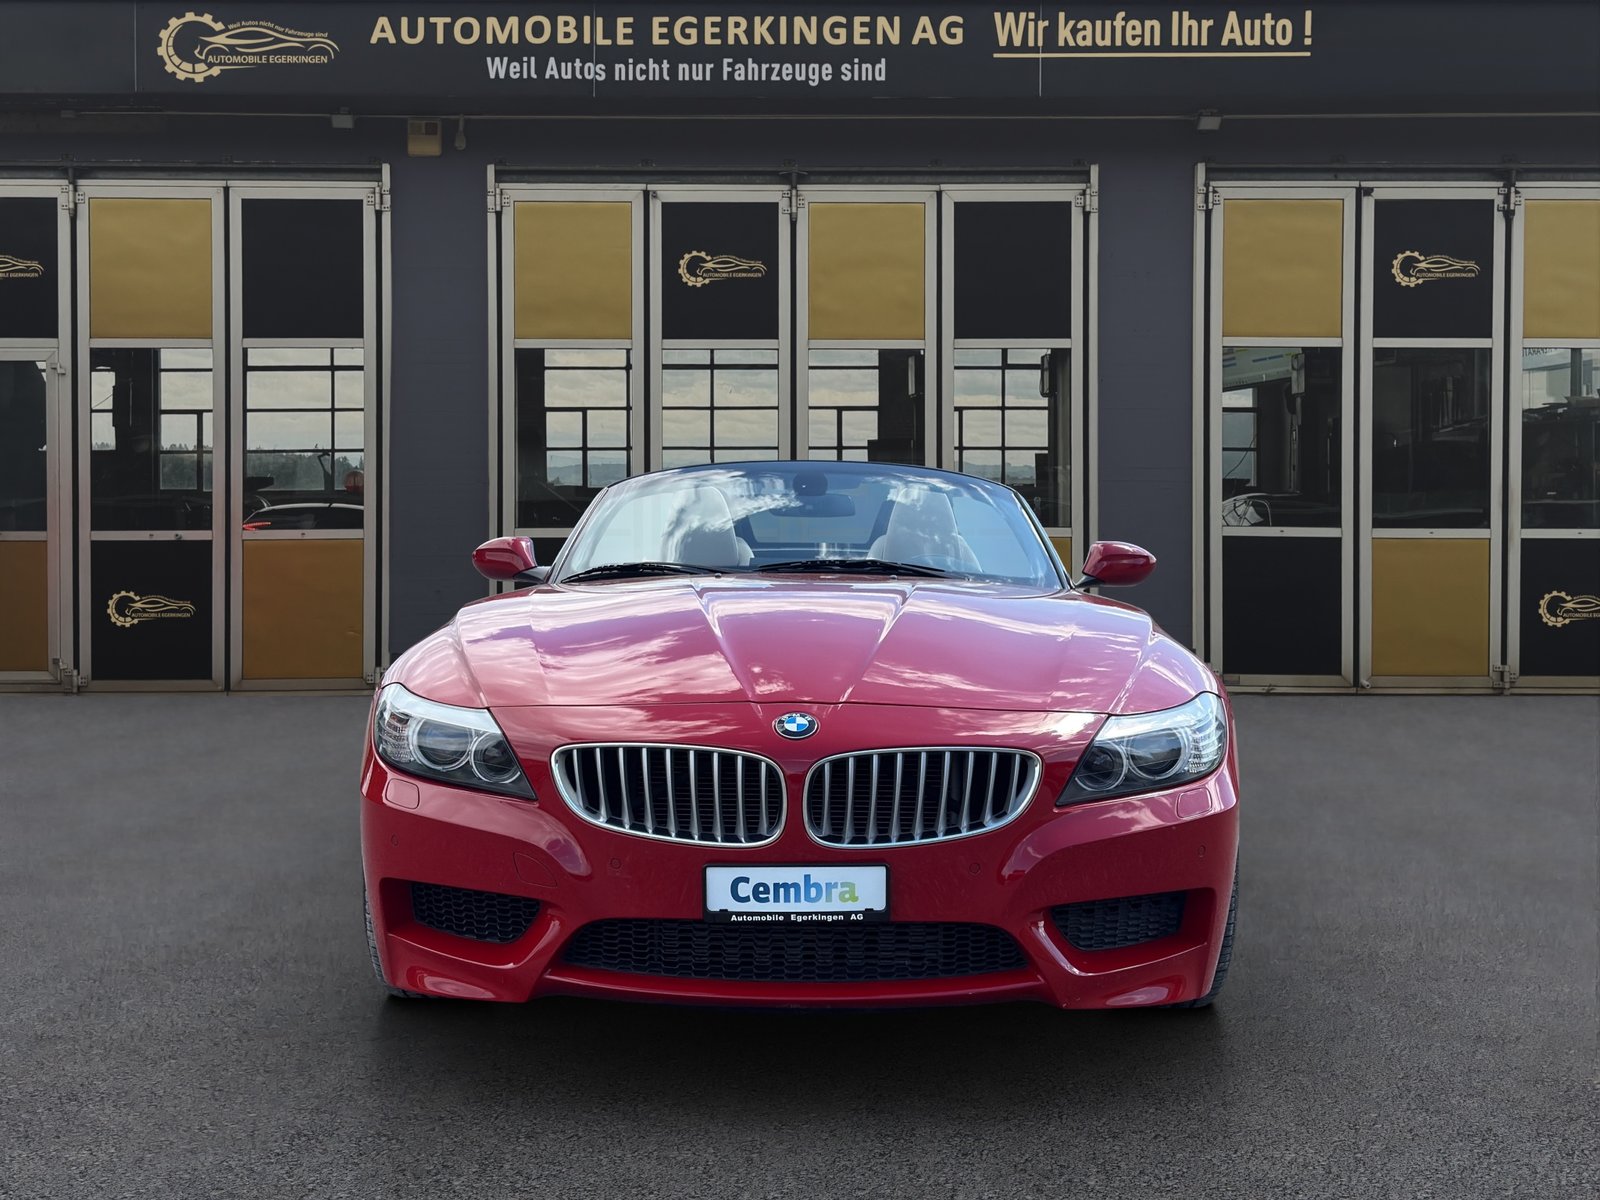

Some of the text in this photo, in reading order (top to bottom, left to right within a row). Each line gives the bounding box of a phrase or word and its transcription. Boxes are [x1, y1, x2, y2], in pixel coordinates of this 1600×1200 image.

[227, 22, 241, 30] Weil
[259, 20, 275, 29] nicht
[284, 27, 315, 37] Fahrzeuge
[369, 15, 964, 46] AUTOMOBILE EGERKINGEN AG
[994, 11, 1049, 47] Wir
[1057, 11, 1161, 47] kaufen
[1171, 10, 1213, 47] Ihr
[1221, 10, 1293, 47] Auto
[207, 54, 328, 64] AUTOMOBILE EGERKINGEN
[486, 56, 886, 88] Weil Autos nicht nur Fahrzeuge sind
[730, 873, 859, 904] Cembra
[730, 913, 864, 923] Automobile Egerkingen AG
